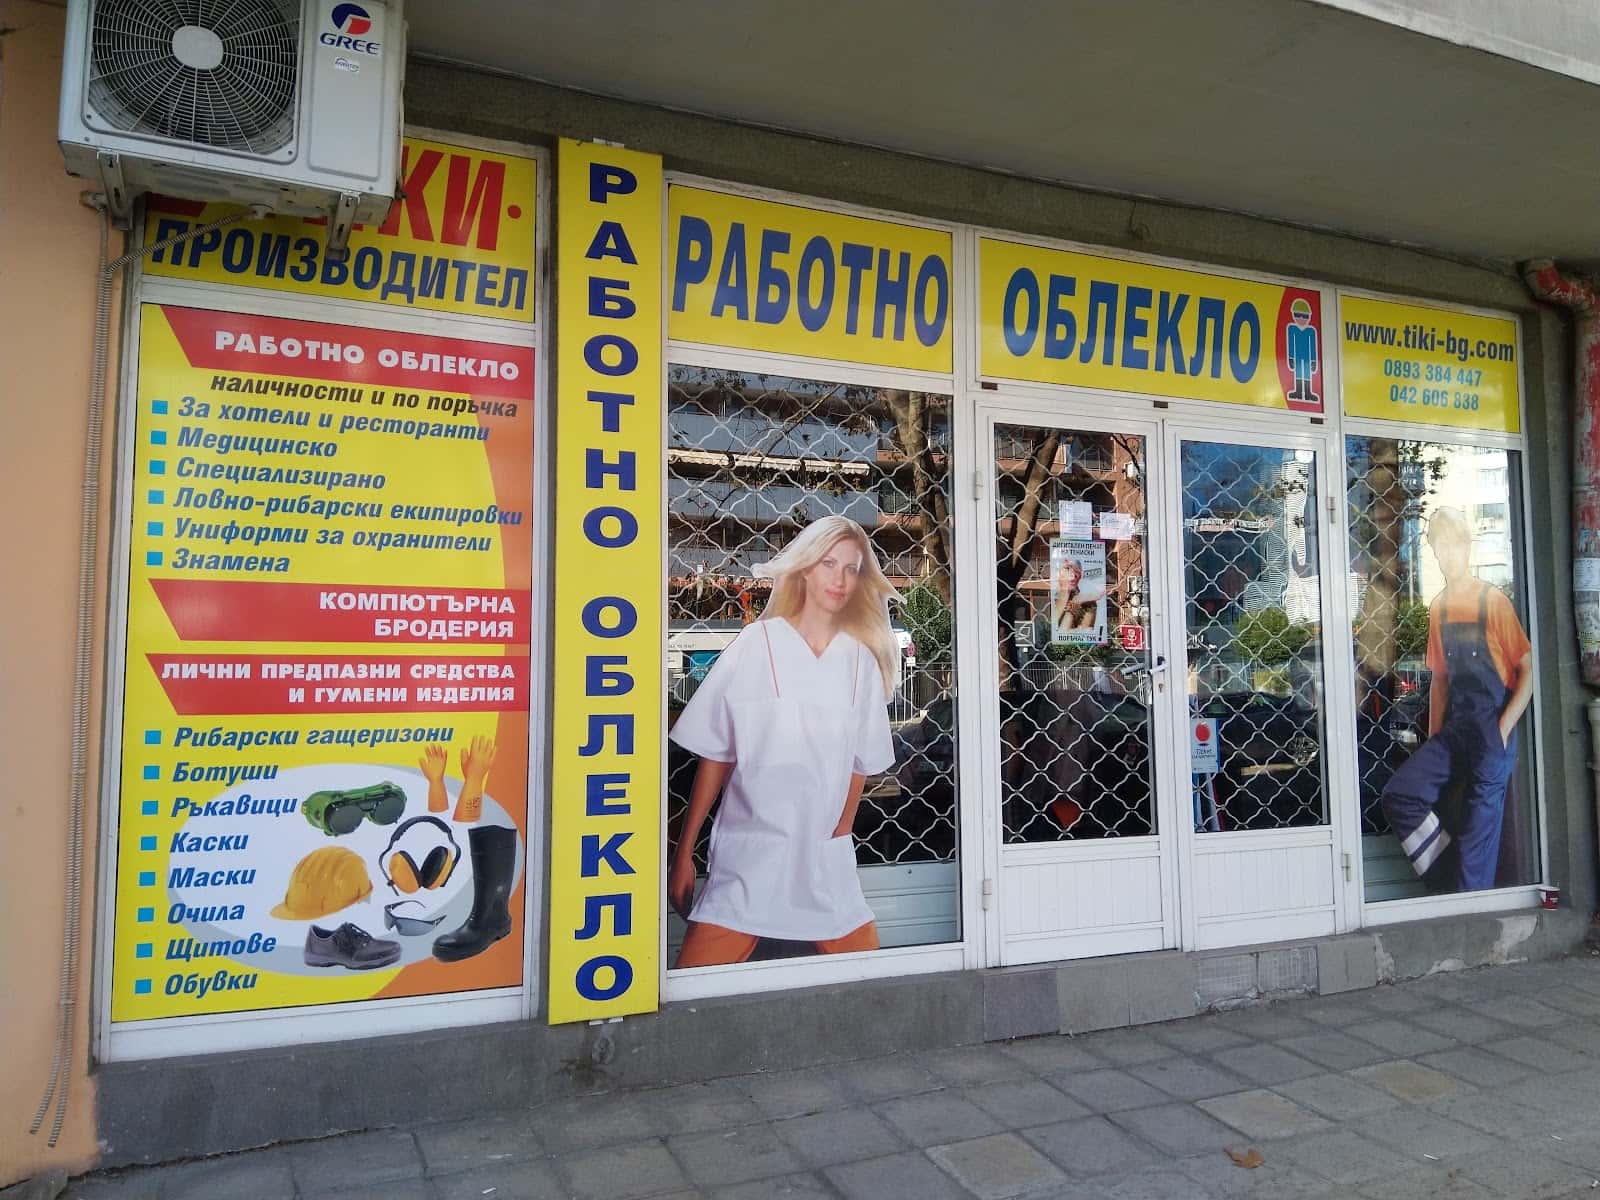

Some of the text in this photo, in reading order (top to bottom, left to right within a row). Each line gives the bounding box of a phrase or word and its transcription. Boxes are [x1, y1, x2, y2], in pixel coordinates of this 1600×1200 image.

[320, 32, 381, 55] GREE
[151, 218, 529, 311] ПРОИЗВОДИТЕЛ
[672, 215, 1261, 384] РАБОТНО ОБЛЕКЛО
[1345, 320, 1514, 362] www.tiki-bg.com
[214, 331, 520, 381] РАБОТНО ОБЛЕКЛО
[1383, 358, 1482, 387] 0893 384 447
[210, 374, 518, 418] наличности и по поръчка
[1390, 384, 1479, 410] 042 606 838
[178, 396, 490, 442] За хотели и ресторанти
[177, 426, 338, 457] Медицинско
[176, 456, 386, 490] Специализирано
[173, 487, 523, 527] Ловно-рибарски екипировки
[173, 518, 492, 553] Униформи за охранители
[172, 548, 290, 573] Знамена
[575, 162, 639, 1000] РАБОТНО ОБЛЕКЛО
[319, 592, 515, 614] КОМПЮТЪРНА
[375, 619, 514, 640] БРОДЕРИЯ
[161, 663, 515, 681] ЛИЧНИ ПРЕДПАЗНИ СРЕДСТВА
[289, 687, 515, 704] И ГУМЕНИ ИЗДЕЛИЯ
[172, 726, 454, 751] Рибарски гащеризони
[172, 761, 279, 787] Ботуши
[171, 794, 298, 818] Ръкавици
[170, 832, 249, 852] Каски
[168, 866, 256, 889] Маски
[167, 903, 245, 924] Очила
[165, 932, 277, 963] Щитове
[165, 970, 258, 999] Обувки
